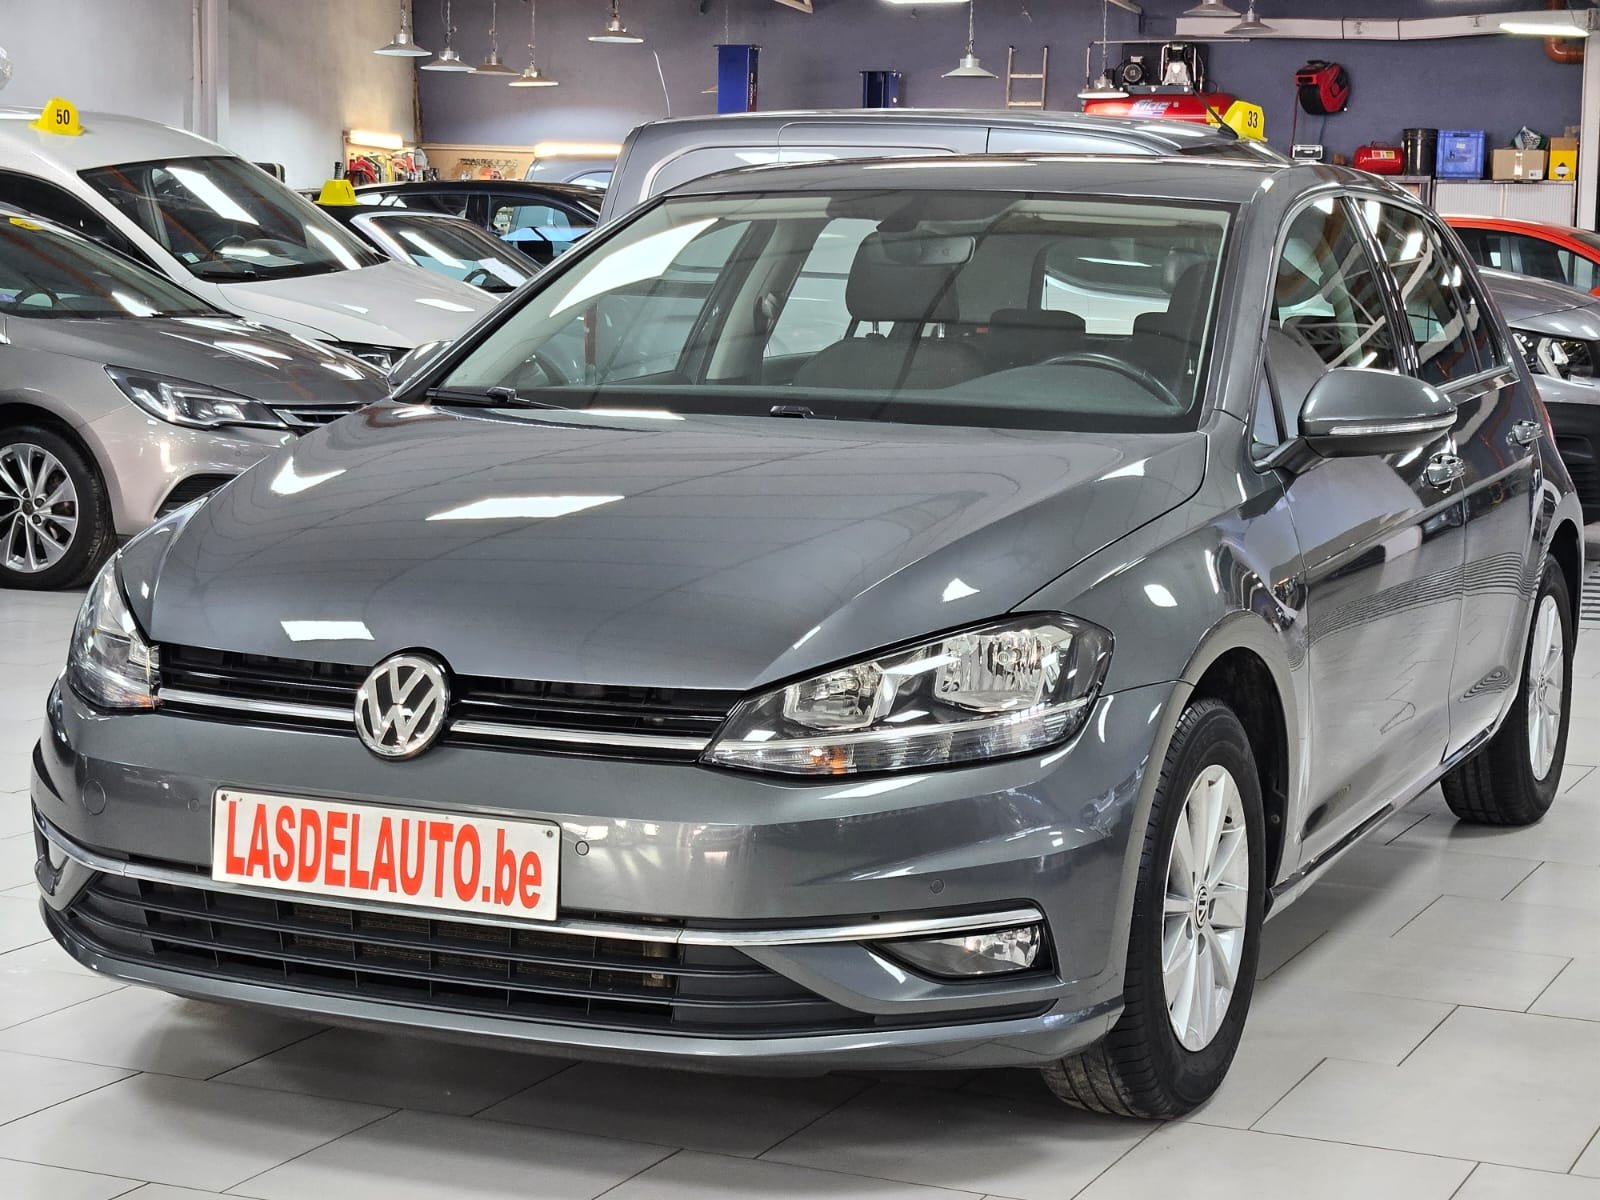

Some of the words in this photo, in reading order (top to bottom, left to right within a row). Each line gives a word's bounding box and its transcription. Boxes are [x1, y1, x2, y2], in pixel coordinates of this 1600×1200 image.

[56, 108, 70, 125] 50
[1247, 110, 1258, 129] 33
[225, 800, 543, 909] LASDELAUTO.be
